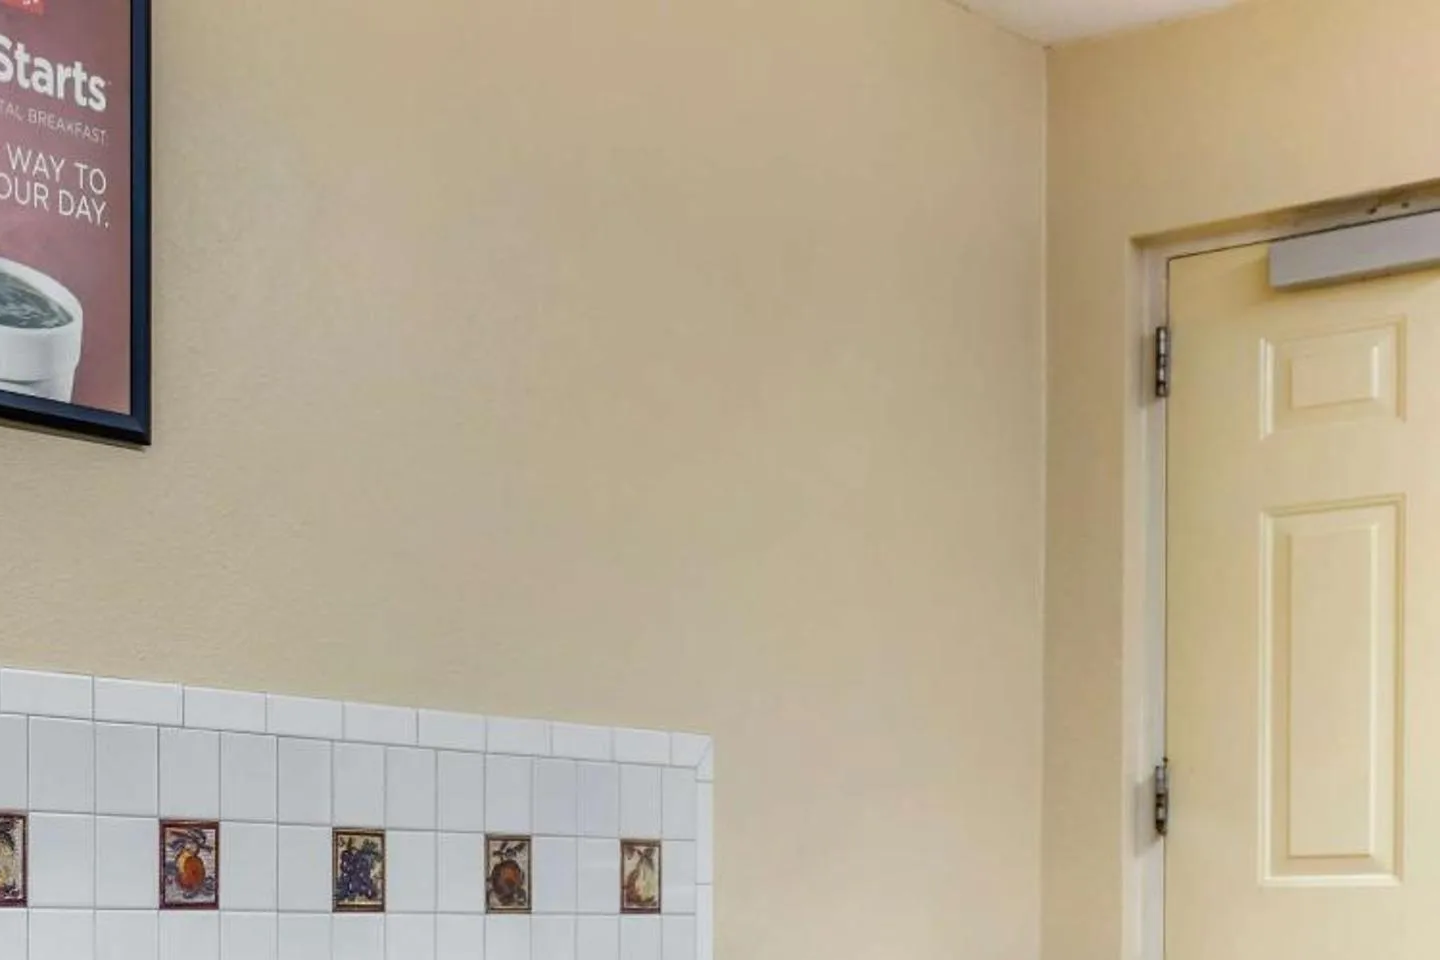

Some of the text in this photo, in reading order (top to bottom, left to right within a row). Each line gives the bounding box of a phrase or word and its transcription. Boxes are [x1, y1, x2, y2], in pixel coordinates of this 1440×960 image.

[6, 141, 65, 183] WAY
[73, 162, 107, 195] TO
[58, 189, 110, 229] DAY.
